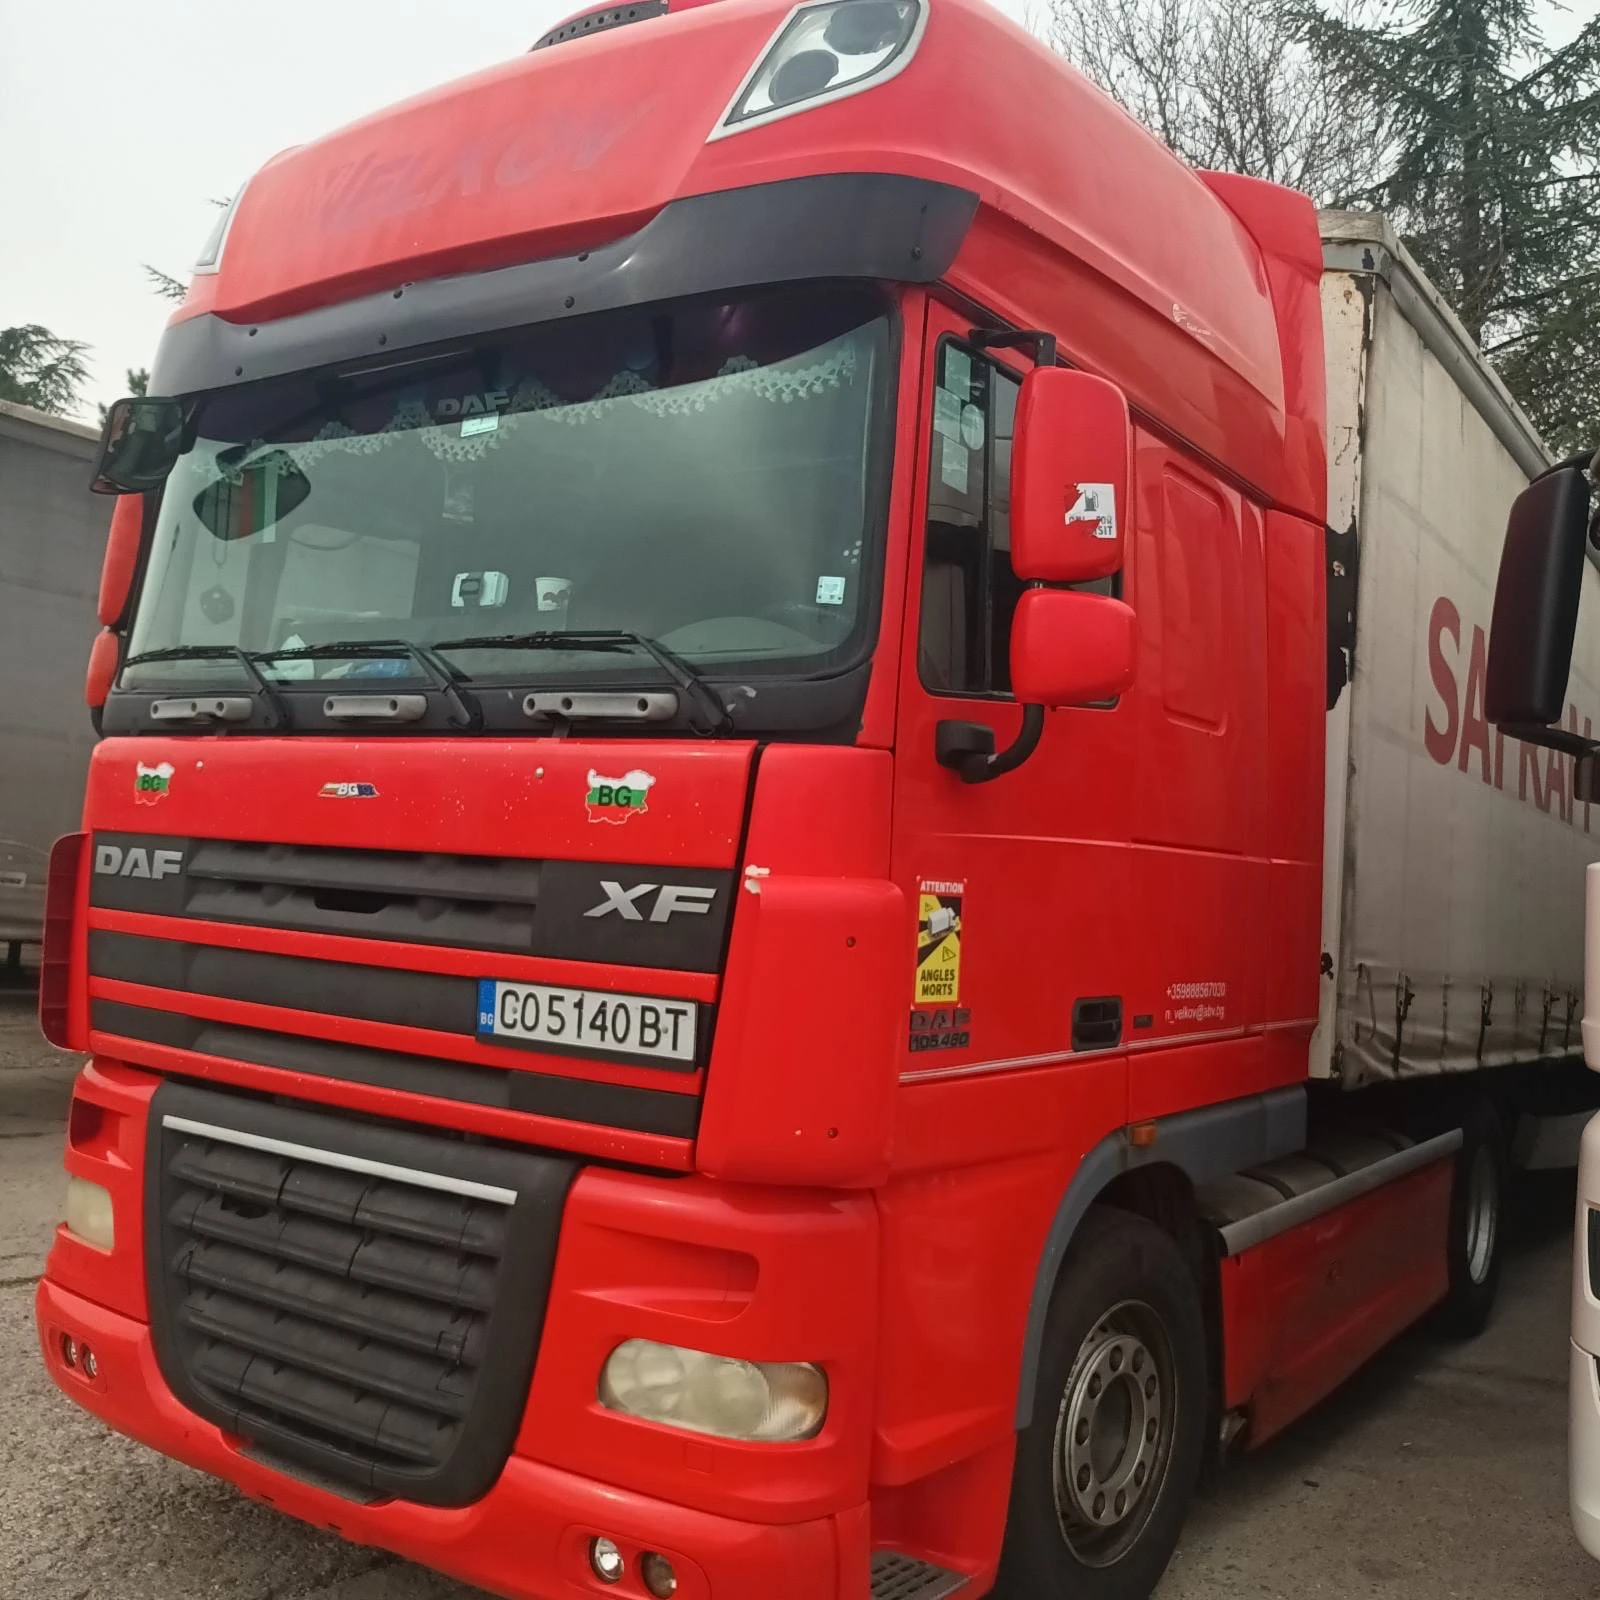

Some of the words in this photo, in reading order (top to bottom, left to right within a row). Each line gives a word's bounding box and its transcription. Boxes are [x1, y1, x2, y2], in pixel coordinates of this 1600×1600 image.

[142, 773, 162, 792] BG
[337, 783, 359, 797] BG
[597, 784, 632, 808] BG
[95, 844, 184, 880] DAF
[920, 879, 965, 894] ATTENTION
[583, 880, 718, 922] XF
[920, 968, 956, 982] ANGLES
[921, 983, 953, 997] MORTS
[480, 1011, 495, 1026] BG
[910, 1008, 971, 1031] DAF
